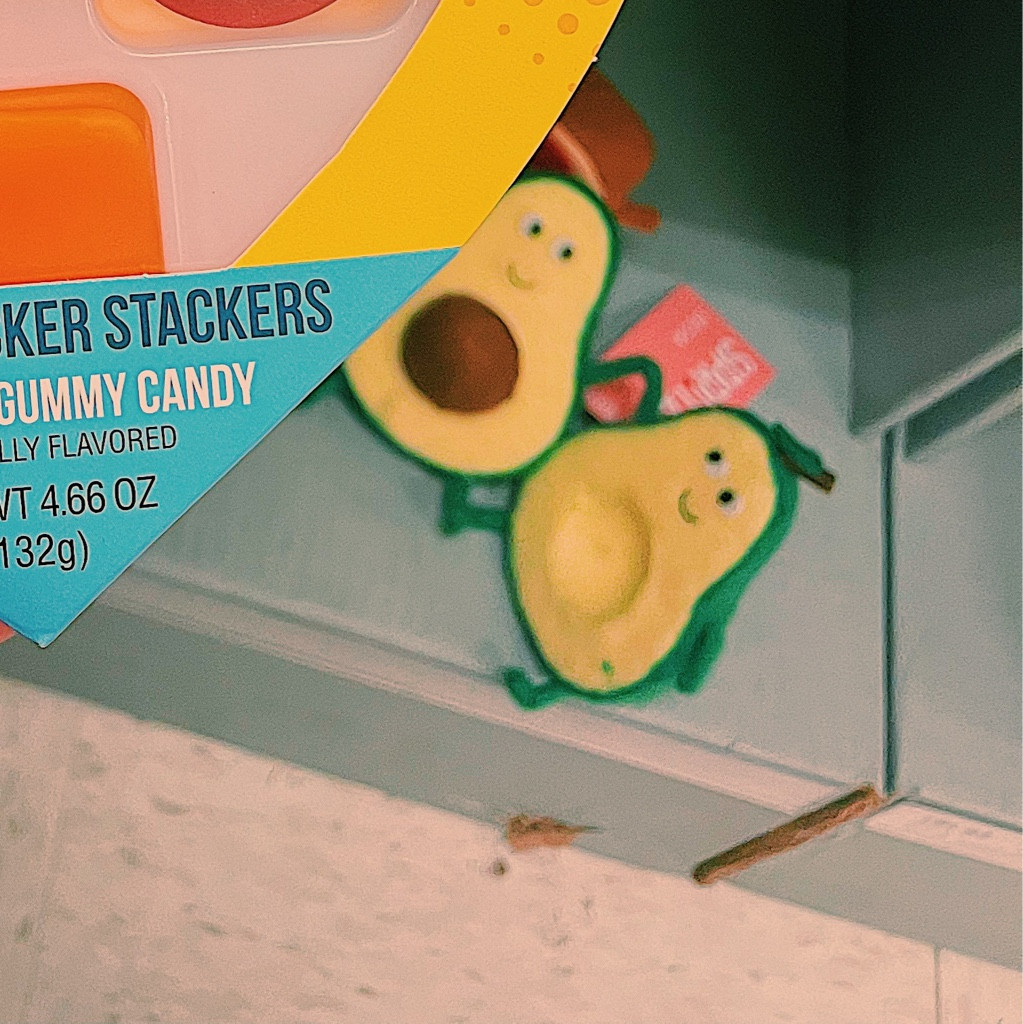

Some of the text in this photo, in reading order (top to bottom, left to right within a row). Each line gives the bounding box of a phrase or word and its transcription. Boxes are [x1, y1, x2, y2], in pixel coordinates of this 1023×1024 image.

[102, 279, 333, 350] STACKERS
[136, 361, 256, 414] CANDY
[48, 424, 177, 459] FLAVORED
[40, 480, 106, 517] 4.66
[114, 475, 159, 512] OZ
